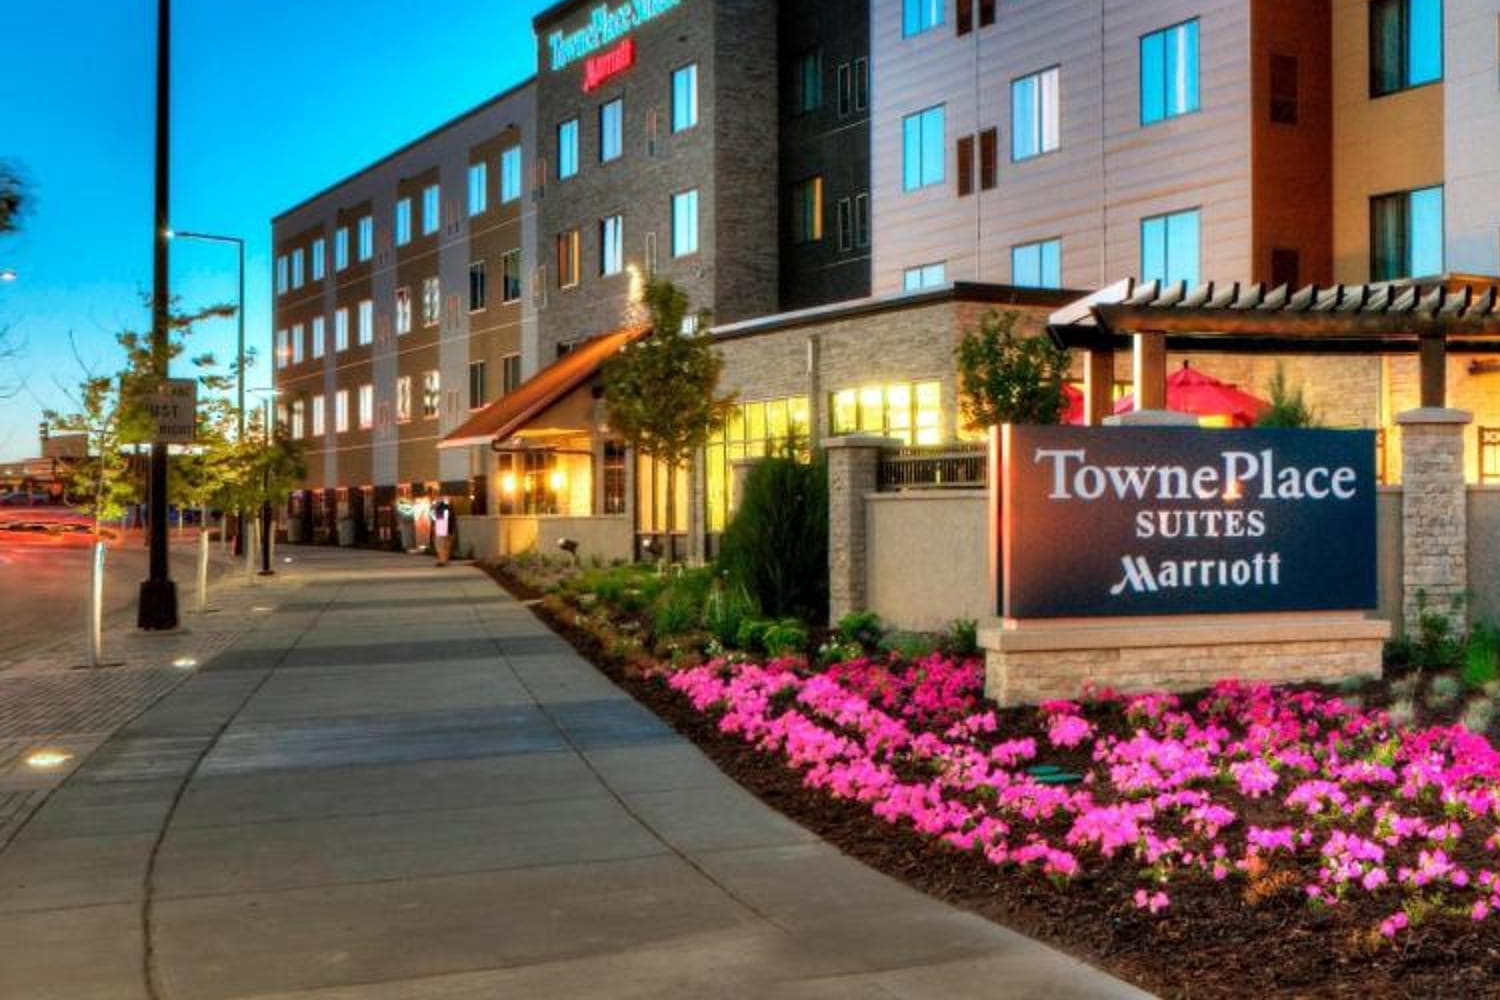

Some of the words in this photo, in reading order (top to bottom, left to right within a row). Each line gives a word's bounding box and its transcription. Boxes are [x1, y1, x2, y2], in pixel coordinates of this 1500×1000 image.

[548, 2, 632, 71] TownePlace
[1034, 447, 1357, 500] TownePlace
[1135, 509, 1267, 539] SUITES
[1109, 551, 1281, 596] Marriott
